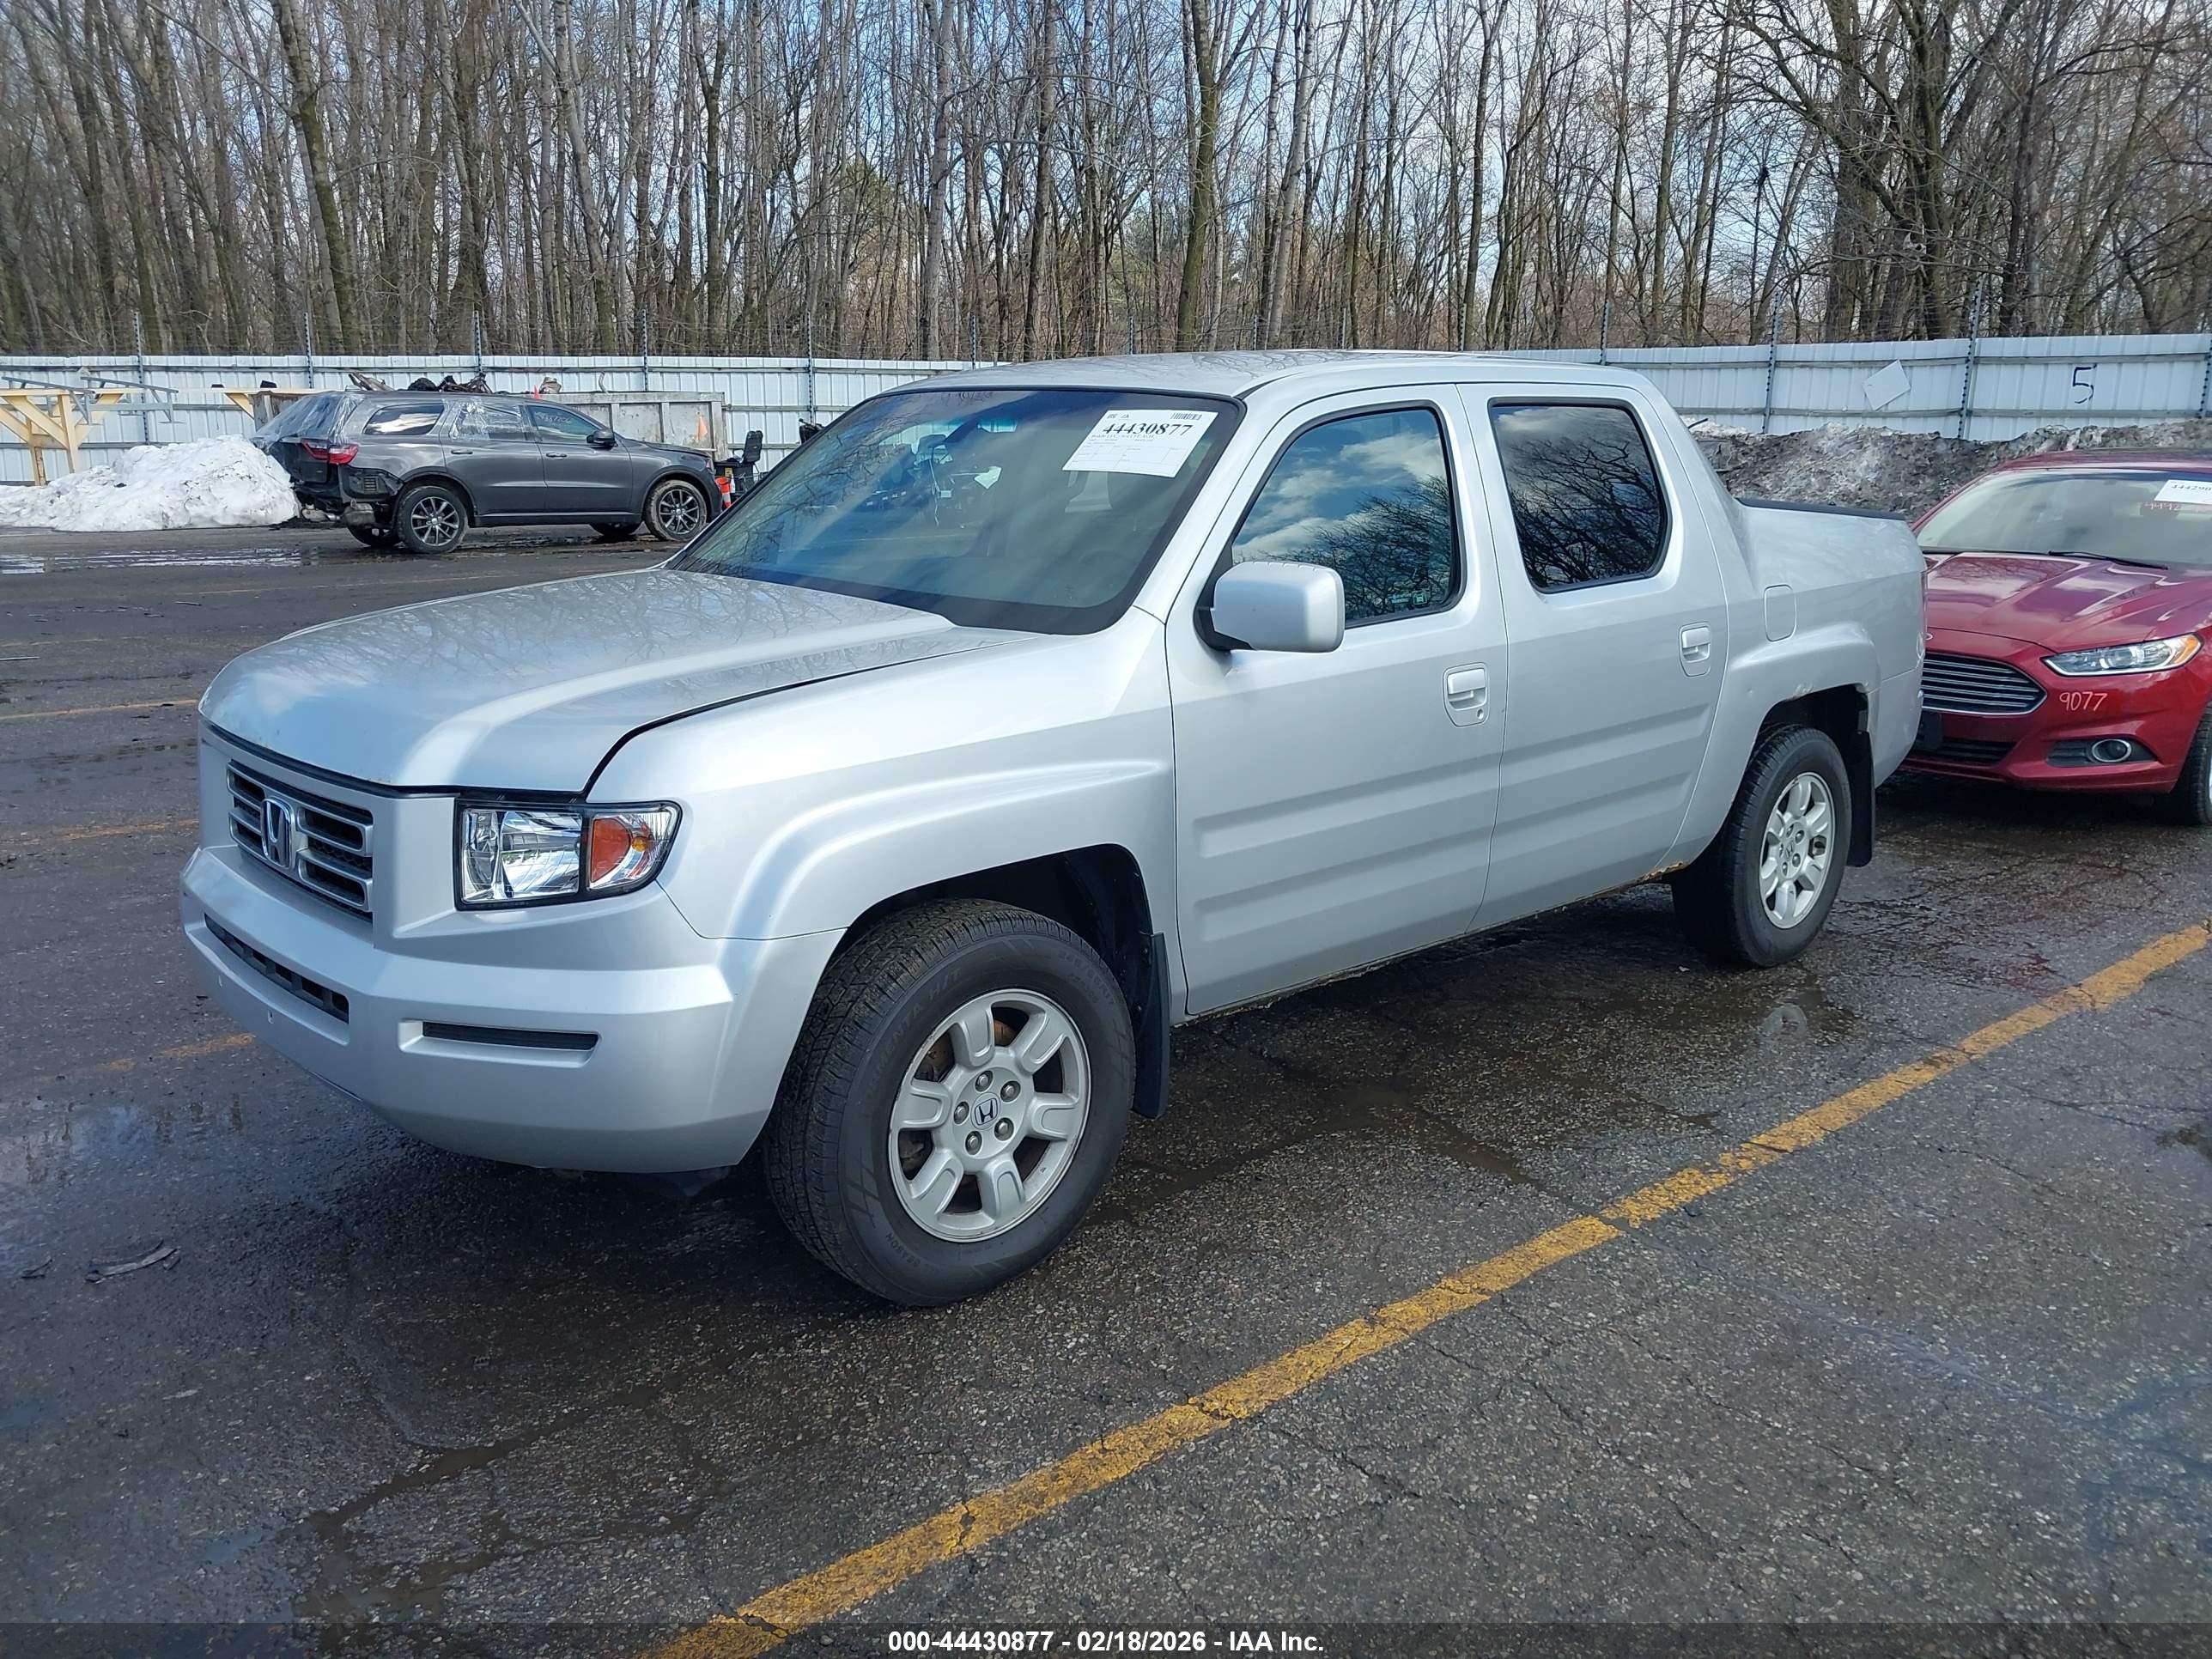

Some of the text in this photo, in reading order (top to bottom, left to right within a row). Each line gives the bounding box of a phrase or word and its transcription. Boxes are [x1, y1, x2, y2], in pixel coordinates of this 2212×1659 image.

[2073, 364, 2097, 404] 5
[1103, 422, 1194, 436] 44430877
[2059, 691, 2108, 712] 9077
